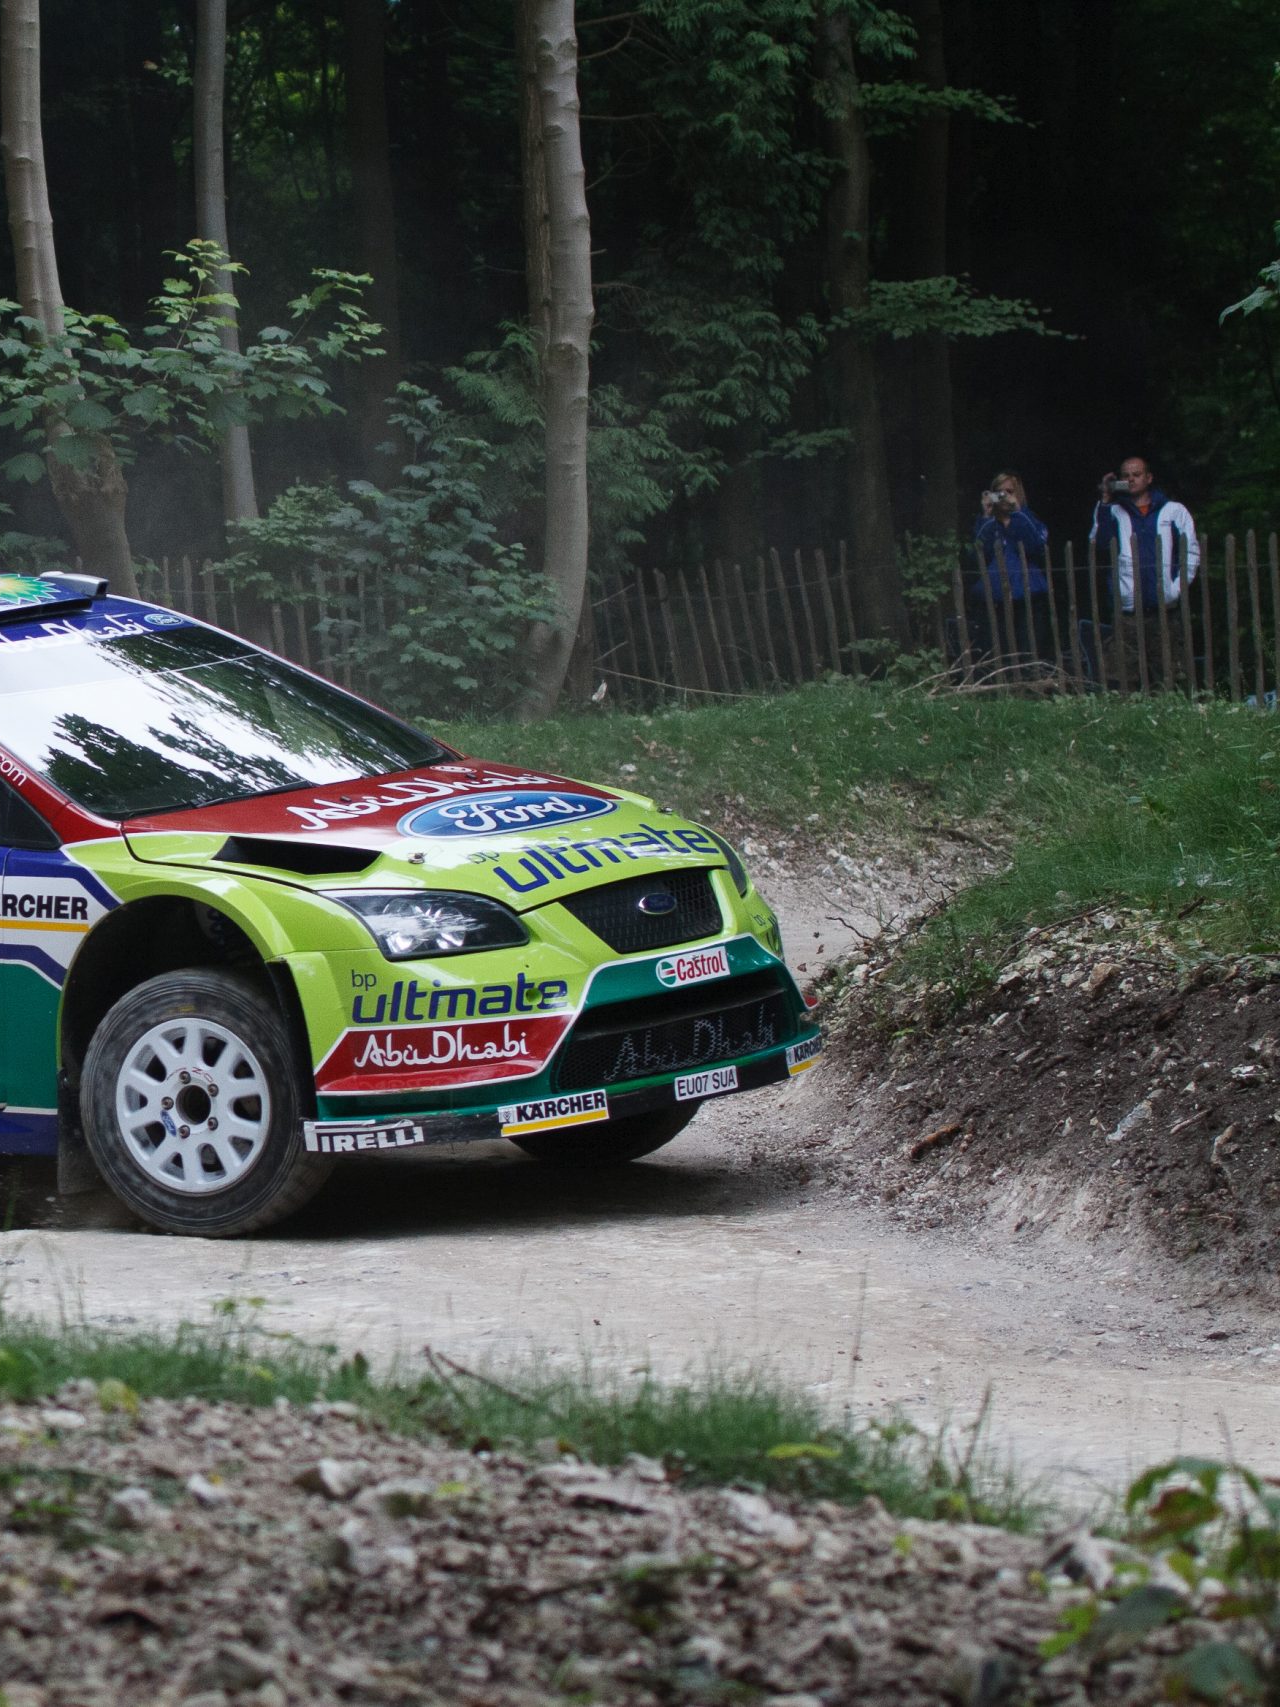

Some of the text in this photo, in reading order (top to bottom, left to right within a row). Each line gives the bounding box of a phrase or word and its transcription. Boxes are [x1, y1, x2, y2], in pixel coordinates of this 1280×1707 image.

[287, 769, 566, 830] Abu Dhabi
[438, 796, 586, 832] Ford
[493, 824, 720, 893] ultimate
[351, 970, 377, 991] bp
[677, 950, 726, 981] Castrol
[352, 972, 568, 1024] ultimate
[354, 1022, 530, 1068] Abu Dhabi
[677, 1068, 736, 1097] EU07 SUA
[516, 1091, 606, 1123] KÄRCHER
